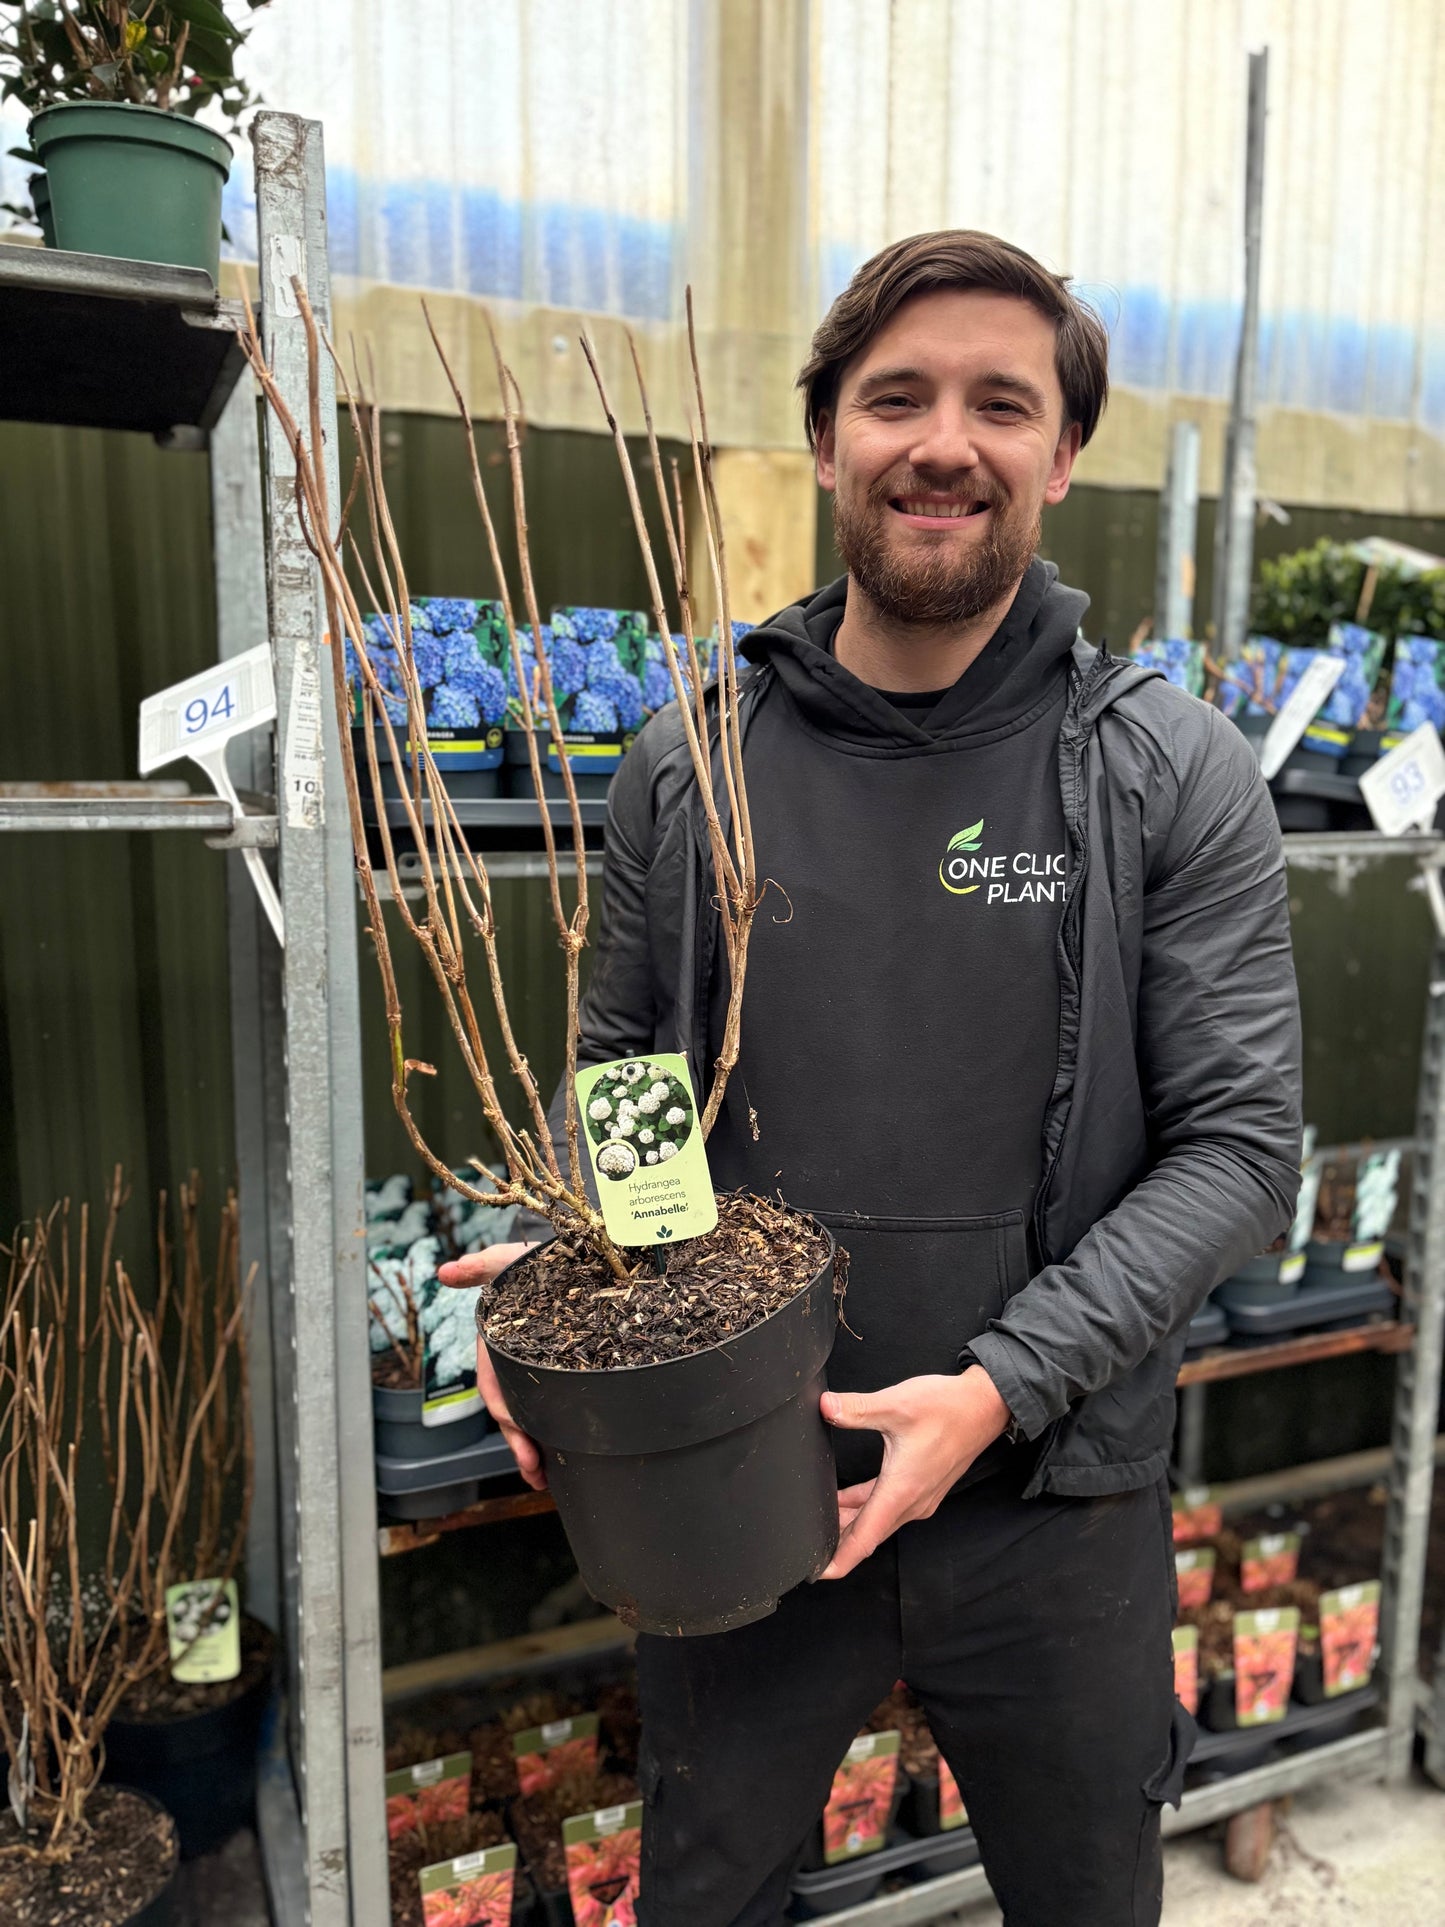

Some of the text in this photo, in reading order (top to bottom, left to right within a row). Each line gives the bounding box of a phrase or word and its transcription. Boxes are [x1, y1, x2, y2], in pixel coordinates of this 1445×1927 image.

[185, 685, 235, 733] 94
[1391, 761, 1425, 805] 93
[948, 852, 1065, 879] ONE CLIC
[628, 1178, 681, 1194] Hydrangea
[629, 1191, 687, 1206] arborescens
